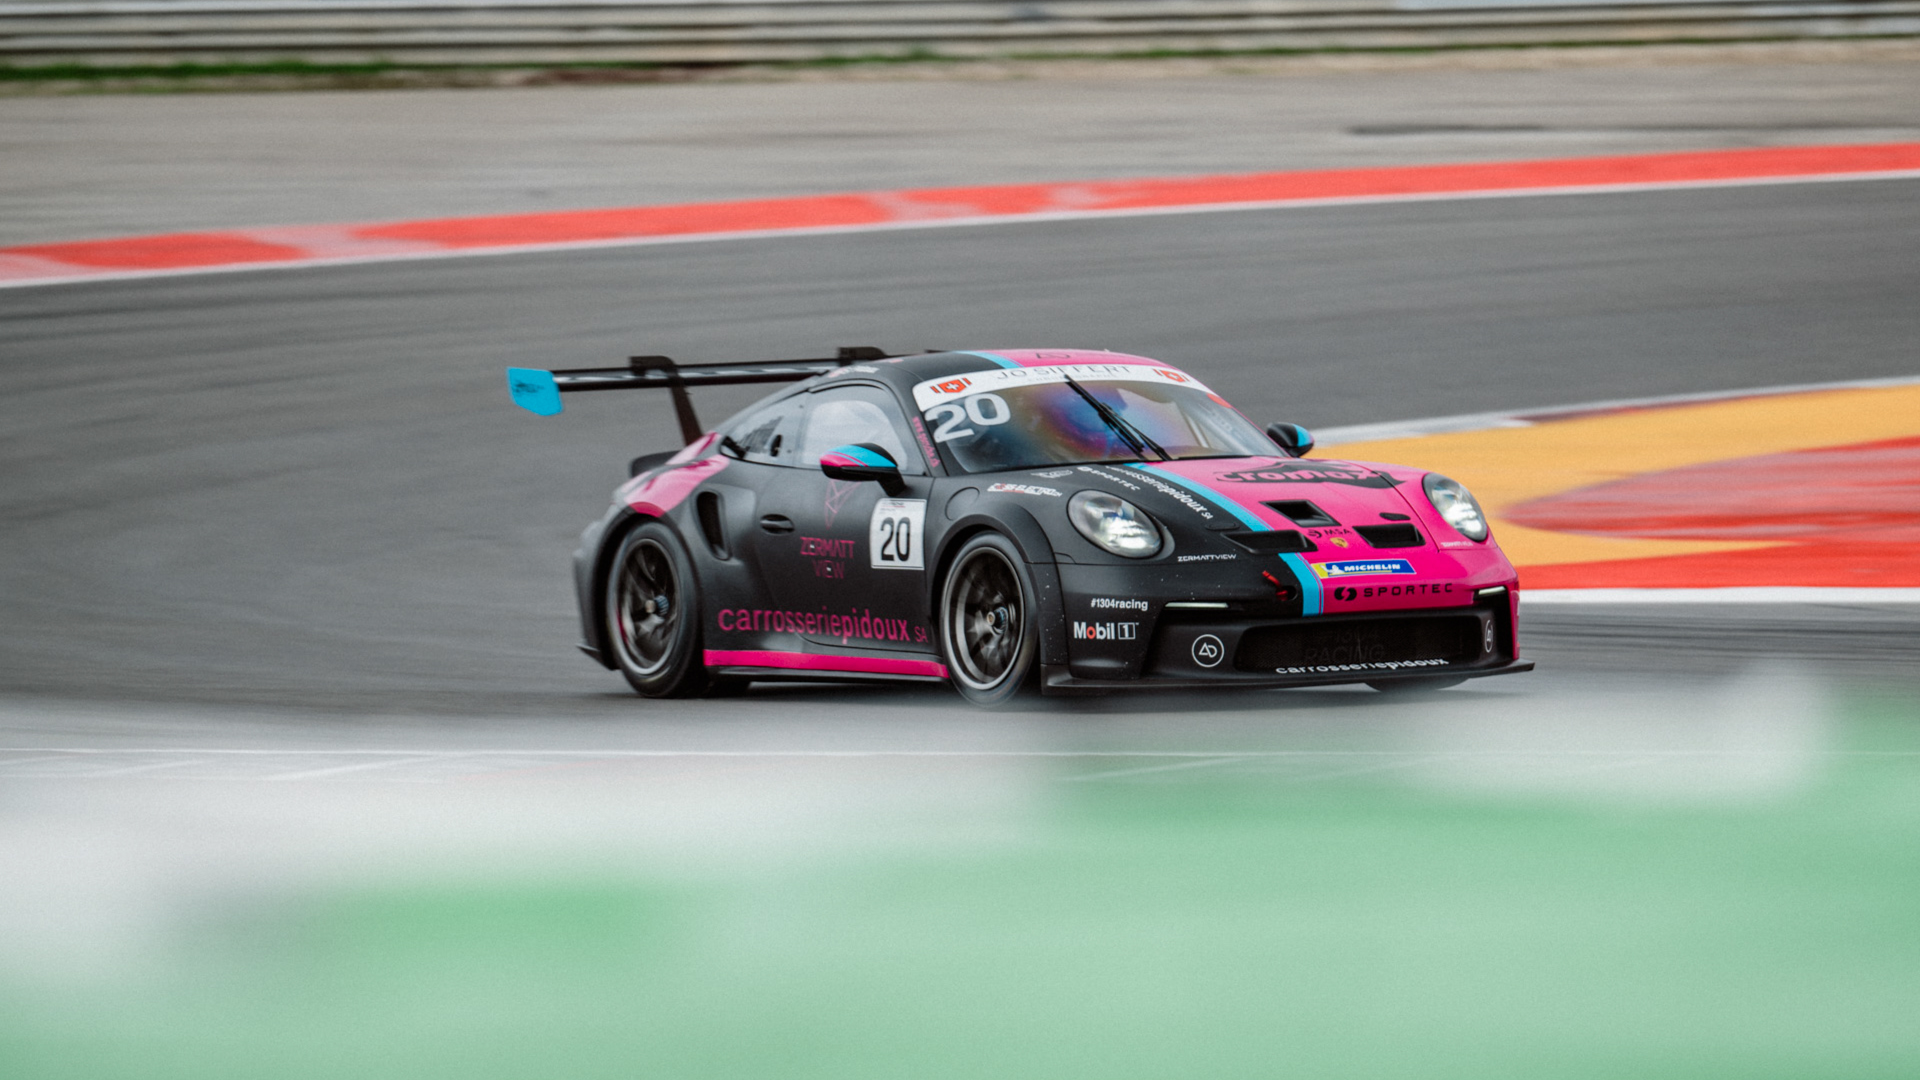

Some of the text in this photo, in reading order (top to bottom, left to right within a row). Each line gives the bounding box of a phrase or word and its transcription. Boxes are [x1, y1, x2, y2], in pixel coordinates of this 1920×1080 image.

[997, 365, 1132, 380] JO SIFFERT
[924, 392, 1011, 444] 20
[879, 516, 911, 562] 20
[1323, 528, 1353, 536] MSA
[800, 536, 856, 559] ZERMATT
[1177, 553, 1237, 563] ZERMATTVIEW
[811, 558, 845, 580] VIEW
[1343, 563, 1401, 573] MICHELIN
[1363, 582, 1454, 597] SPORTEC
[1090, 597, 1149, 612] #1304racing
[717, 605, 929, 645] carrosseriepidoux SA
[1073, 621, 1115, 640] Mobil
[1275, 657, 1450, 675] carrosseriepidoux
